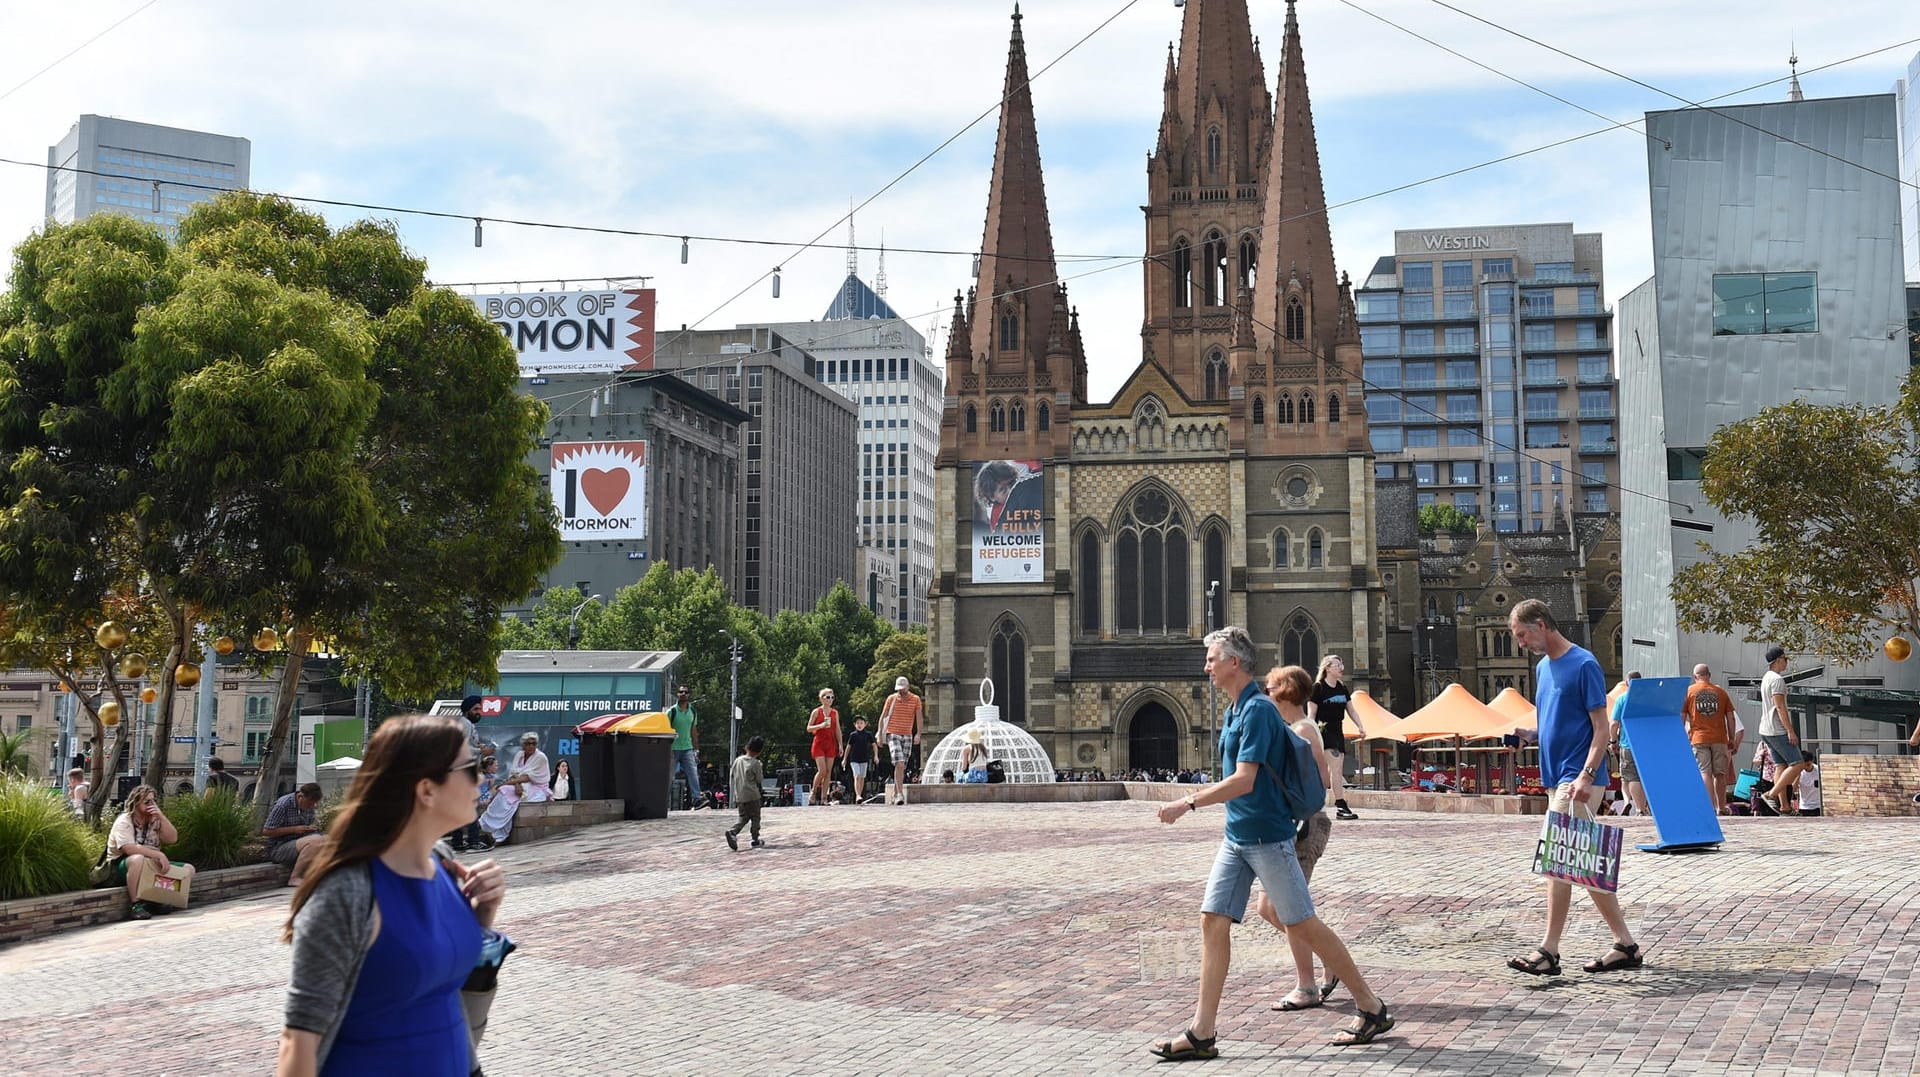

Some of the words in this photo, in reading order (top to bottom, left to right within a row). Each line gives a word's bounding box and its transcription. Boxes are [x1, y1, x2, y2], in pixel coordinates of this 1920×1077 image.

[1422, 234, 1490, 249] WESTIN
[486, 295, 567, 319] BOOK
[577, 294, 616, 316] OF
[1006, 509, 1041, 521] LET'S
[1001, 522, 1041, 533] FULLY
[982, 534, 1041, 546] WELCOME
[979, 547, 1041, 559] REFUGEES
[513, 700, 570, 711] MELBOURNE
[574, 700, 611, 711] VISITOR
[614, 700, 652, 711] CENTRE
[1550, 824, 1591, 851] DAVID
[1547, 841, 1616, 876] HOCKNEY
